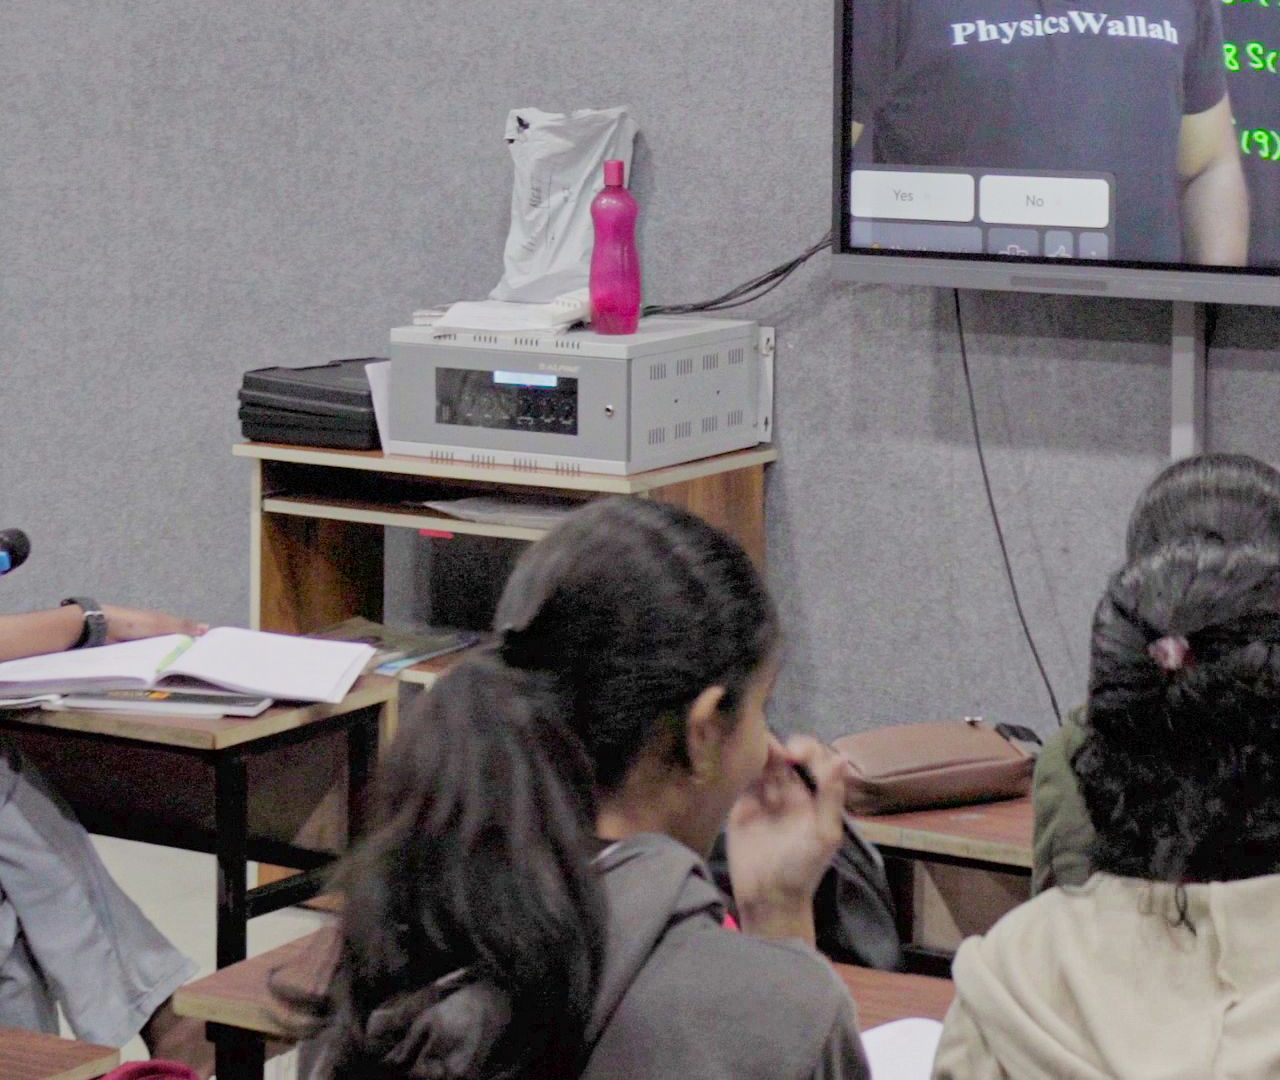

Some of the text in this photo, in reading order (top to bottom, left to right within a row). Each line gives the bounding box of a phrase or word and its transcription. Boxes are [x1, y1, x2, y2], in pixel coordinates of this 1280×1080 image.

[951, 10, 1180, 46] PhysicsWallah
[893, 189, 914, 202] Yes
[1025, 195, 1044, 208] No
